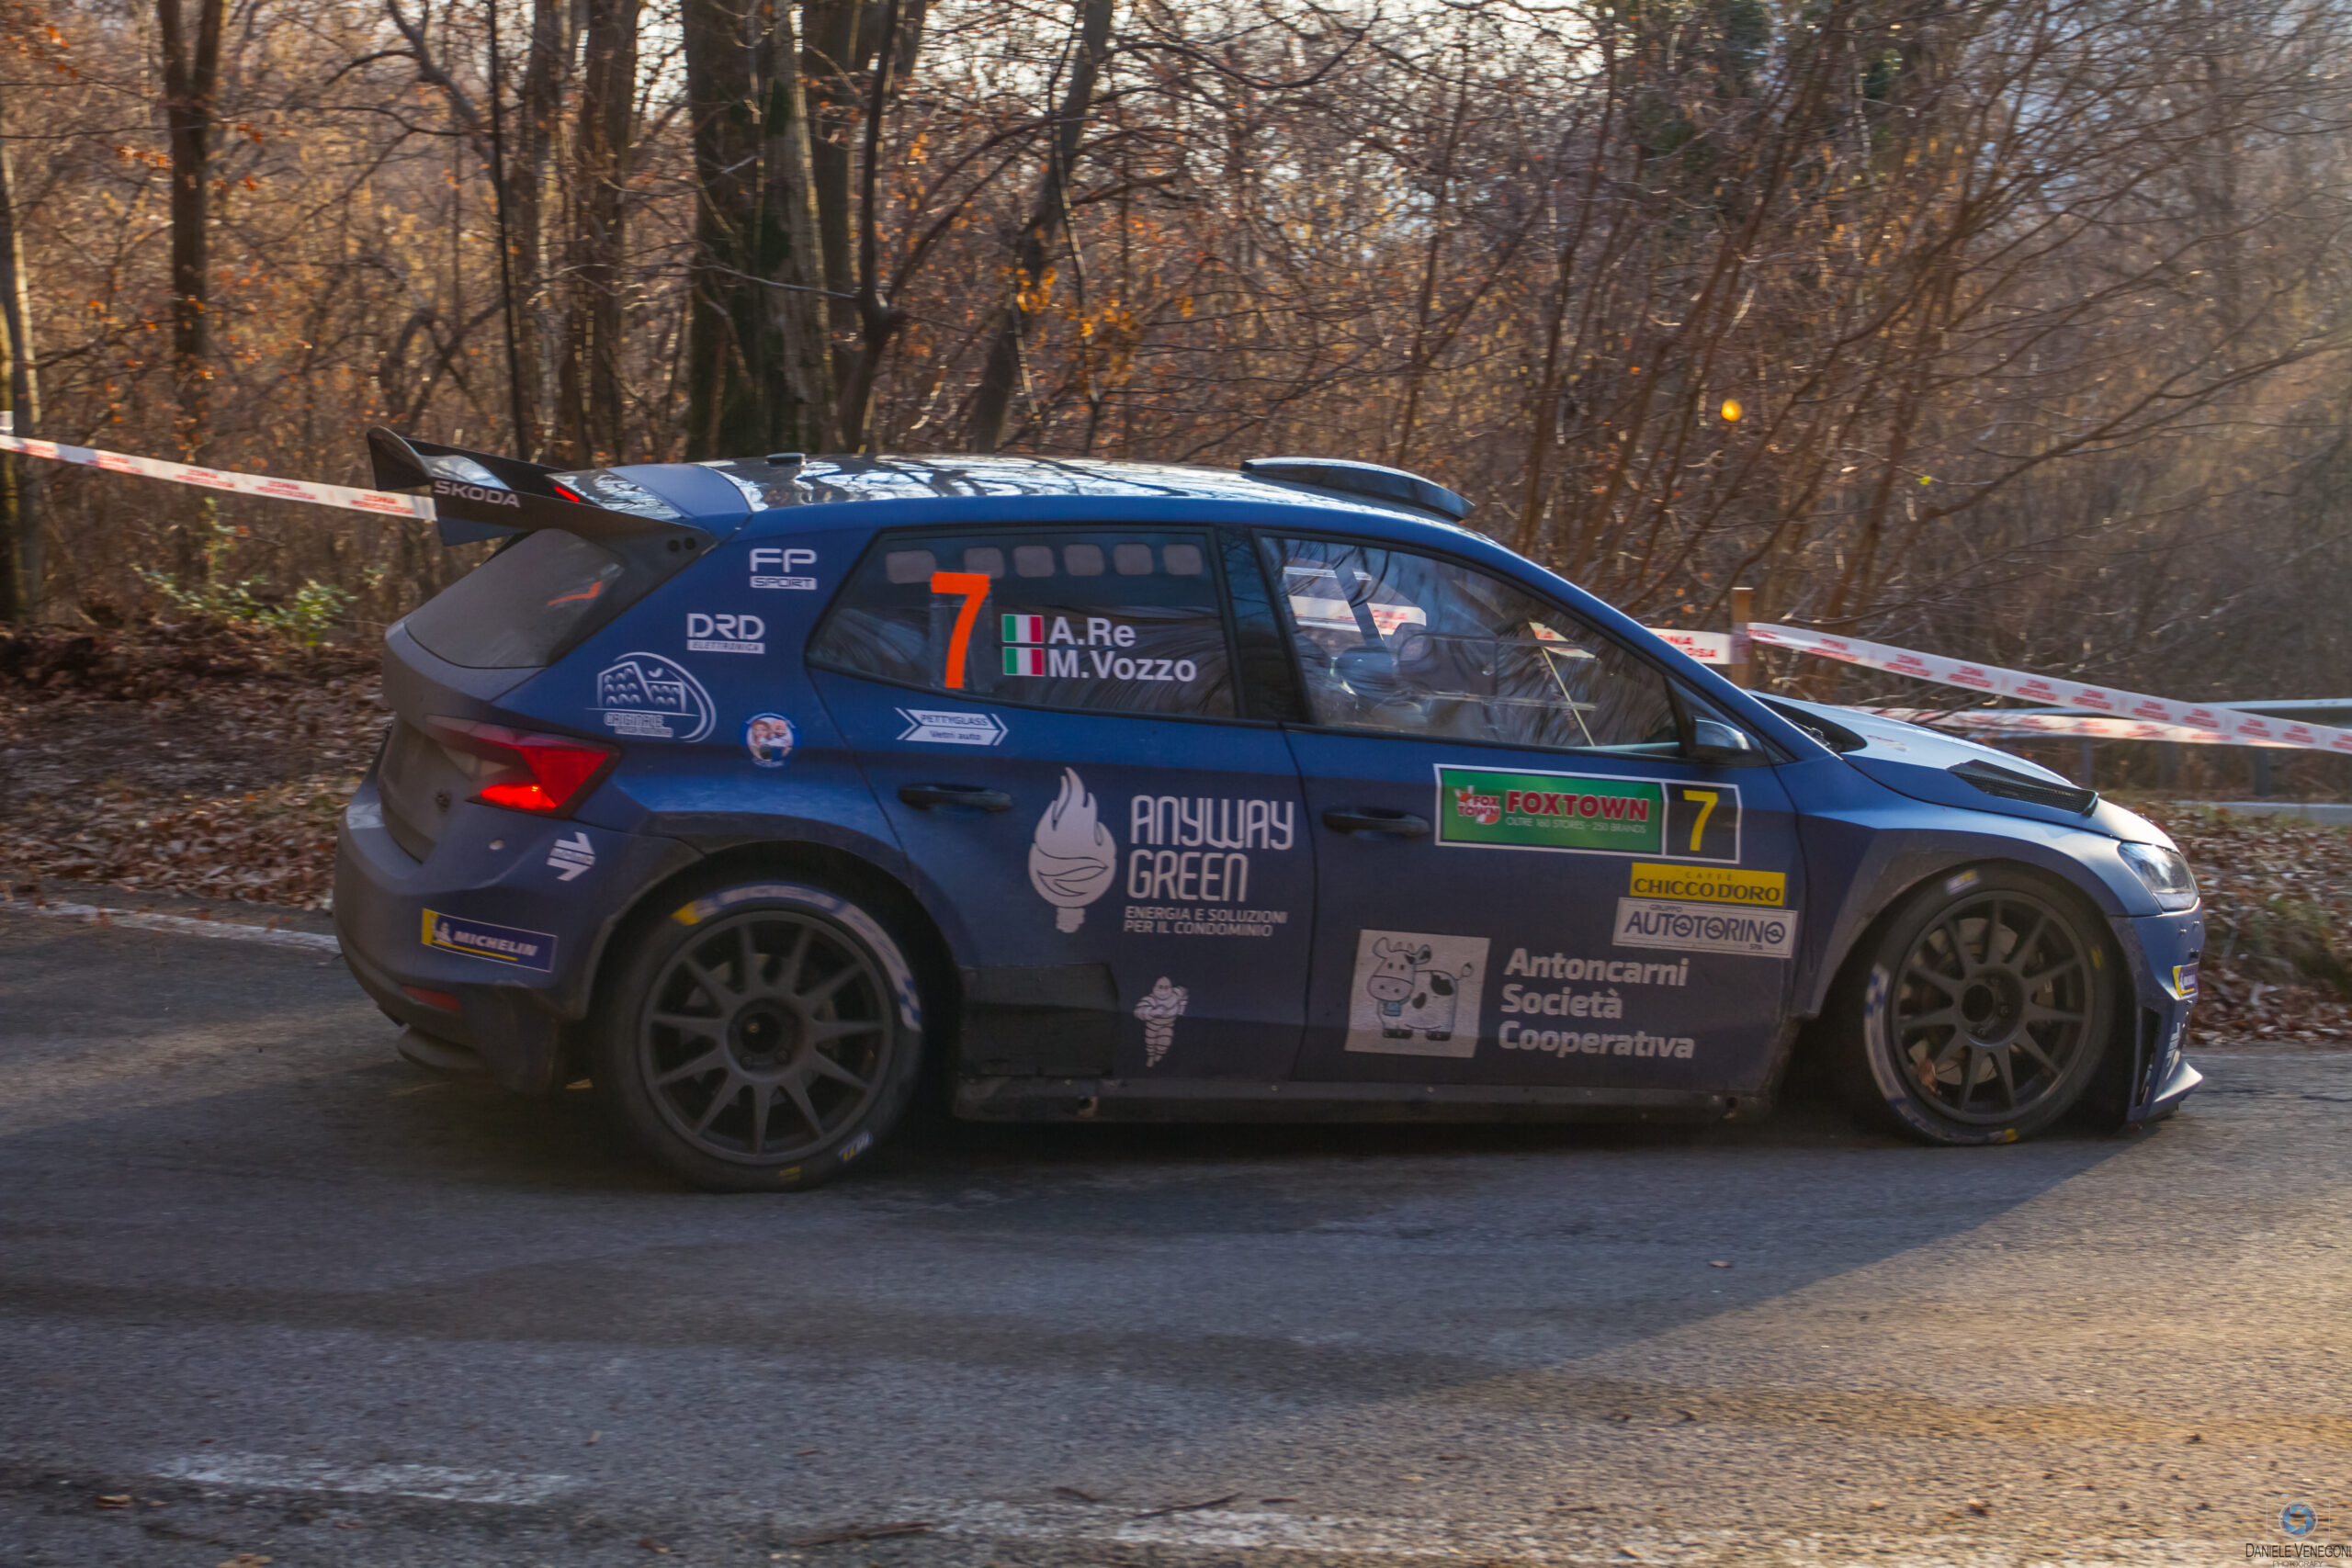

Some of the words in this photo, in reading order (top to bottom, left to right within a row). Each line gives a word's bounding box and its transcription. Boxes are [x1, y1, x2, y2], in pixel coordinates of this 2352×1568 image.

[434, 479, 521, 508] SKODA
[750, 547, 817, 573] FP
[753, 577, 813, 588] SPORT
[687, 613, 765, 640] DRD
[931, 571, 990, 689] 7
[1048, 616, 1136, 648] A.Re
[1048, 649, 1197, 682] M.Vozzo
[1473, 795, 1499, 807] FOX
[1505, 790, 1650, 822] FOXTOWN
[1130, 794, 1295, 851] ANYWAY
[1610, 823, 1647, 834] BRANDS
[1683, 790, 1720, 852] 7
[1126, 848, 1250, 903] GREEN
[1634, 878, 1715, 897] CHICCO
[1123, 919, 1154, 934] PER
[1156, 921, 1170, 934] IL
[1173, 922, 1274, 938] CONDOMINIO
[1124, 906, 1193, 921] ENERGIA
[1194, 908, 1205, 922] E
[1207, 909, 1288, 925] SOLUZIONI
[1623, 910, 1786, 944] AUTOTORINO
[453, 931, 538, 957] MICHELIN
[1503, 947, 1690, 987] Antoncarni
[1500, 983, 1623, 1020] Società
[1498, 1020, 1696, 1059] Cooperativa
